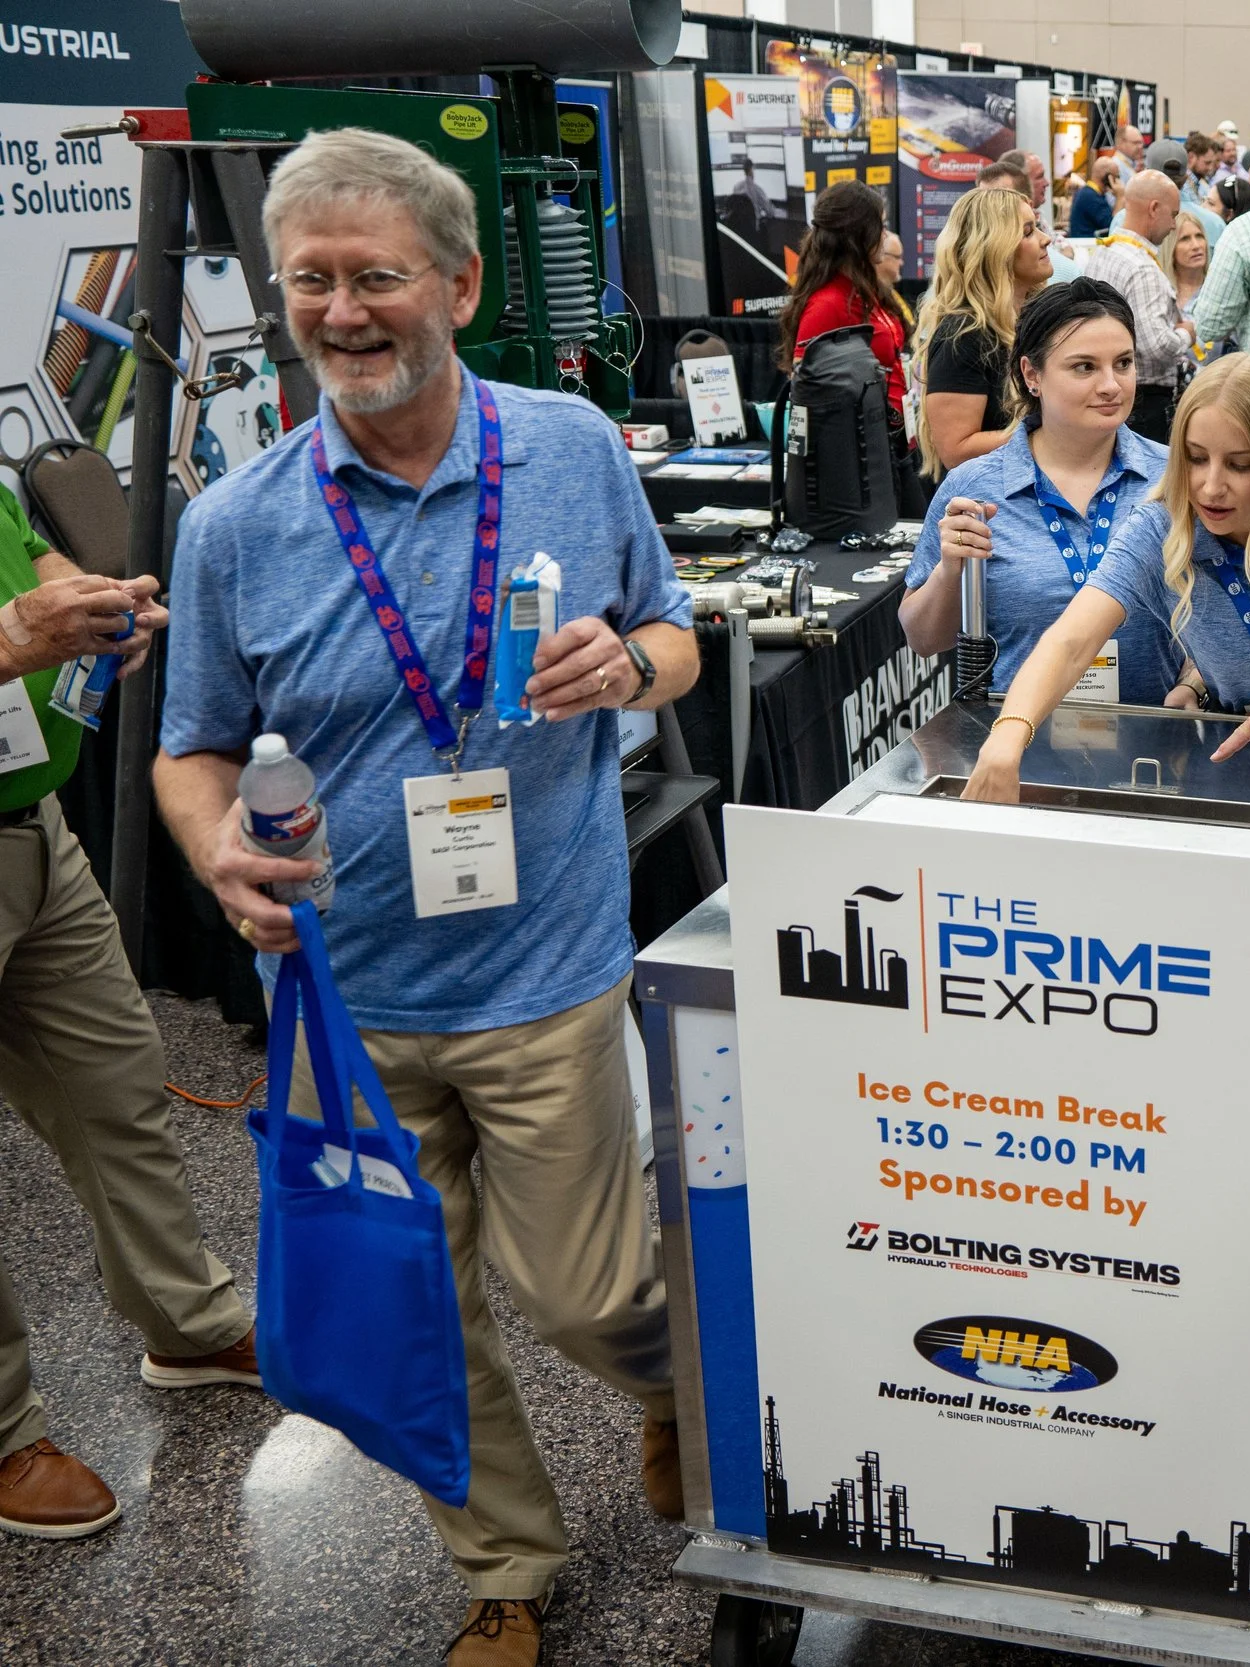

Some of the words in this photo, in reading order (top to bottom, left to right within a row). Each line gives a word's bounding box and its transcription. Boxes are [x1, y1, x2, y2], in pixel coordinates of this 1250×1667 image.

[747, 93, 796, 105] SUPERHEAT
[446, 113, 482, 122] BobbyJack
[55, 135, 103, 166] and
[12, 180, 132, 216] Solutions
[8, 706, 22, 714] Lifts
[10, 752, 31, 761] YELLOW
[443, 823, 481, 834] Wayne
[452, 840, 497, 852] Corporation
[937, 891, 1038, 926] THE
[938, 922, 1211, 997] PRIME
[940, 973, 1158, 1037] EXPO
[857, 1072, 912, 1104] Ice
[923, 1081, 1045, 1120] Cream
[1058, 1095, 1167, 1135] Break
[876, 1116, 949, 1150] 1:30
[994, 1131, 1077, 1165] 2:00
[1090, 1141, 1146, 1175] PM
[879, 1158, 1089, 1212] Sponsored
[1103, 1185, 1148, 1228] by
[887, 1229, 1022, 1266] BOLTING
[1028, 1247, 1181, 1286] SYSTEMS
[887, 1254, 947, 1269] HYDRAULIC
[948, 1261, 1029, 1279] TECHNOLOGIES
[961, 1326, 1072, 1373] NHA
[878, 1381, 974, 1409] National
[979, 1395, 1032, 1417] Hose
[1050, 1405, 1157, 1437] Accessory
[937, 1410, 945, 1418] A
[946, 1411, 984, 1424] SINGER
[986, 1415, 1046, 1432] INDUSTRIAL
[1047, 1424, 1096, 1438] COMPANY
